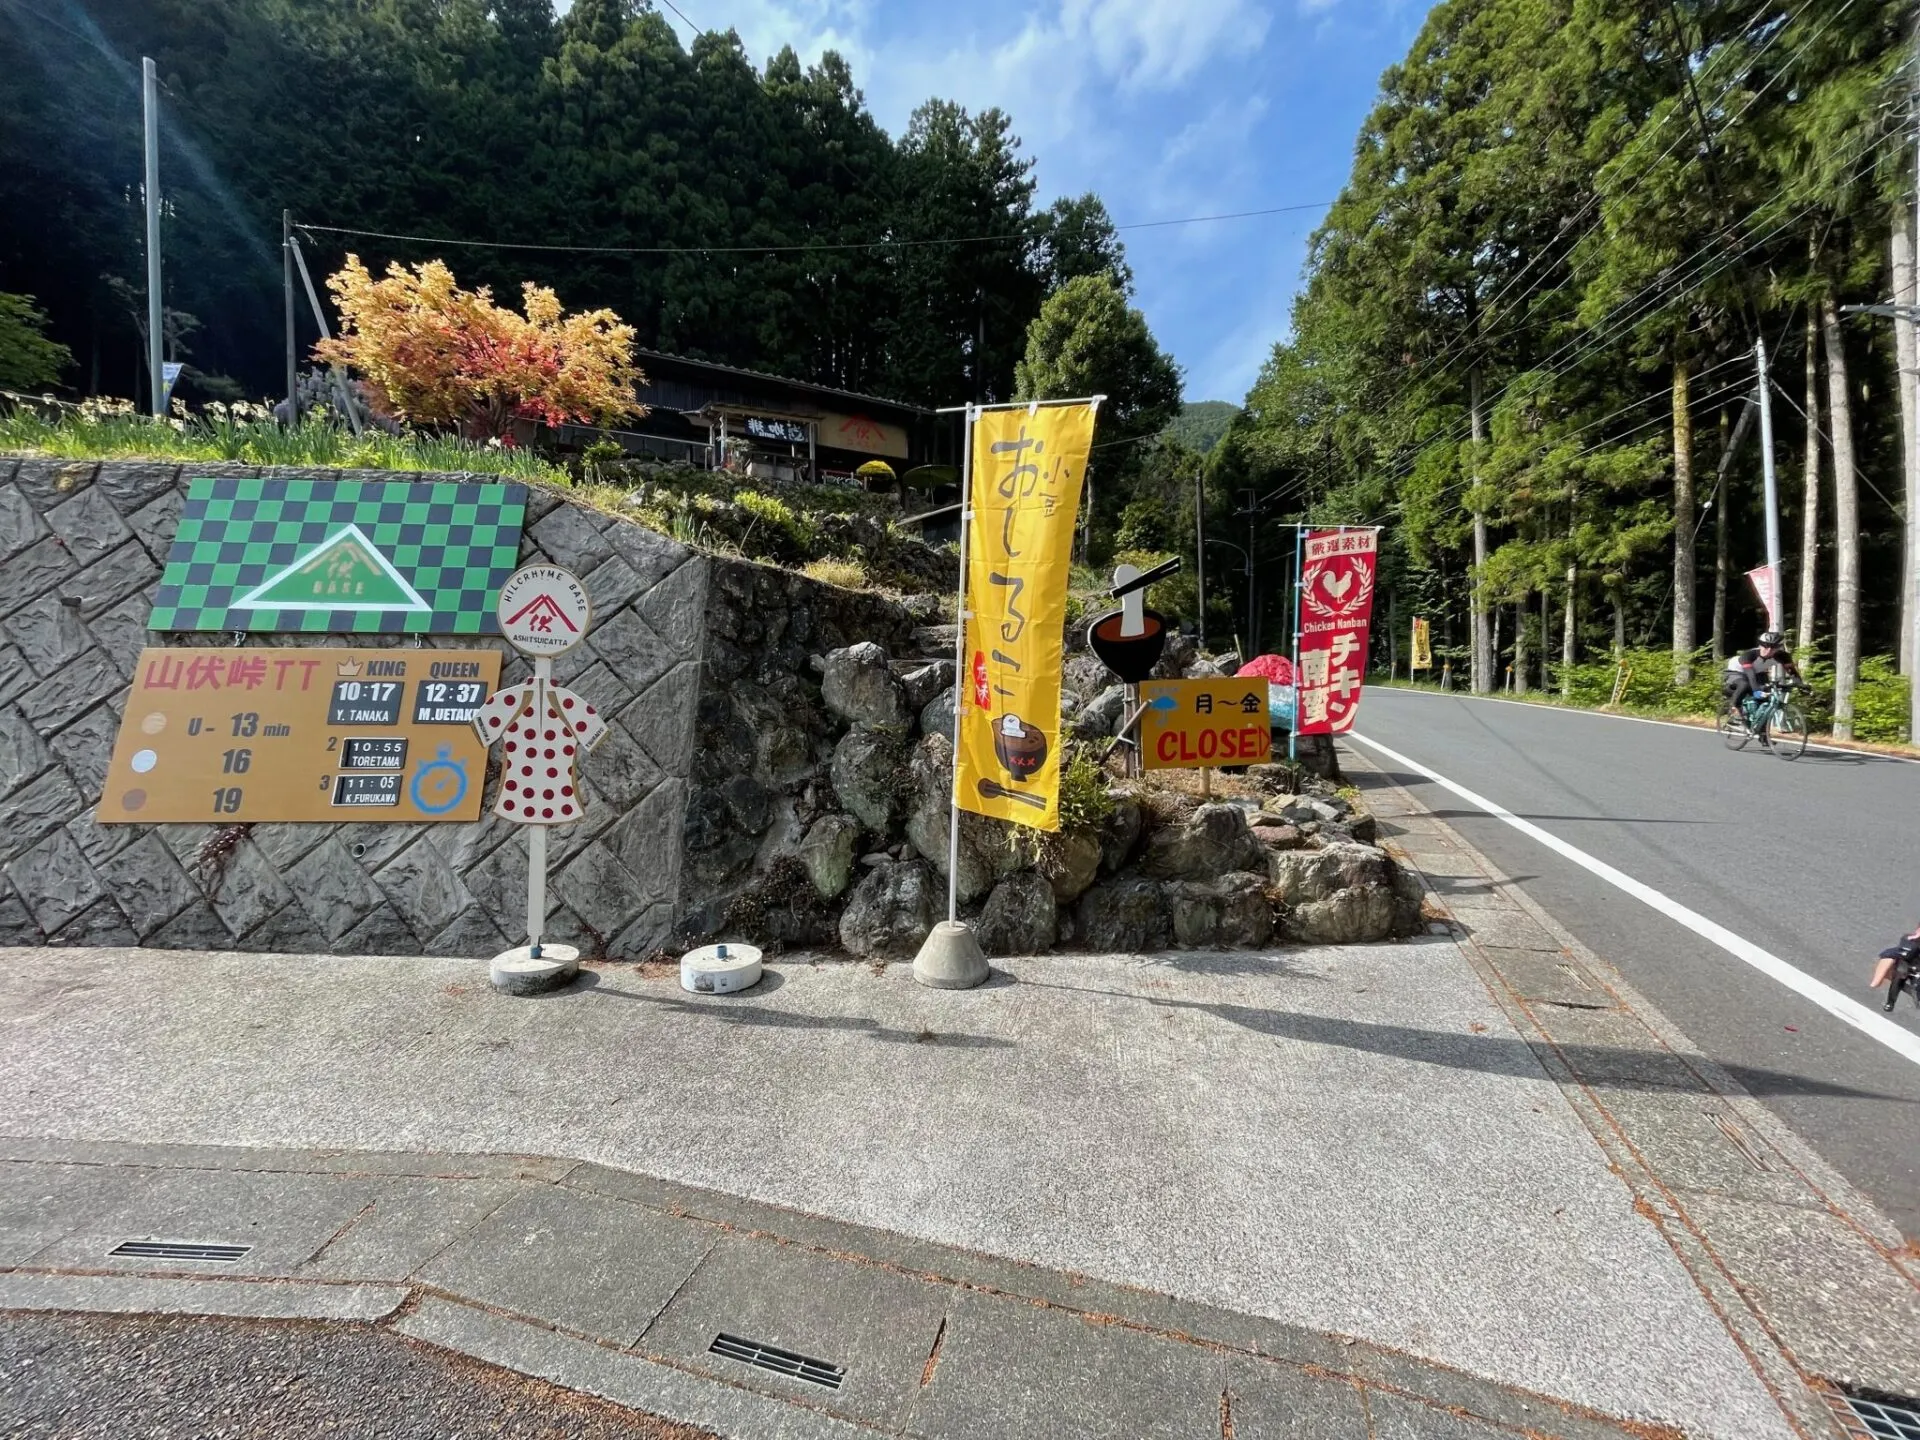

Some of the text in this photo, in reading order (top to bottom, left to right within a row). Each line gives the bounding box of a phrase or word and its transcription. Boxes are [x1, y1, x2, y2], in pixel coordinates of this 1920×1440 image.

[1038, 456, 1070, 518] 小豆
[990, 426, 1044, 697] おしるこ
[312, 580, 364, 595] BASE
[504, 569, 587, 612] HILCRHYME BASE
[1304, 617, 1367, 634] Chicken Nanban
[366, 660, 407, 677] KING
[429, 662, 480, 679] QUEEN
[1331, 631, 1361, 732] チキン
[338, 682, 397, 702] 10:17
[424, 683, 481, 704] 12:37
[336, 709, 389, 722] Y. TANAKA
[231, 712, 260, 738] 13
[263, 723, 291, 738] min
[326, 736, 338, 752] 2
[353, 742, 403, 753] 10:55
[1157, 725, 1272, 762] CLOSED
[222, 748, 253, 775] 16
[352, 756, 401, 768] TORETAMA
[319, 774, 331, 791] 3
[348, 776, 395, 789] 11:05
[212, 787, 244, 814] 19
